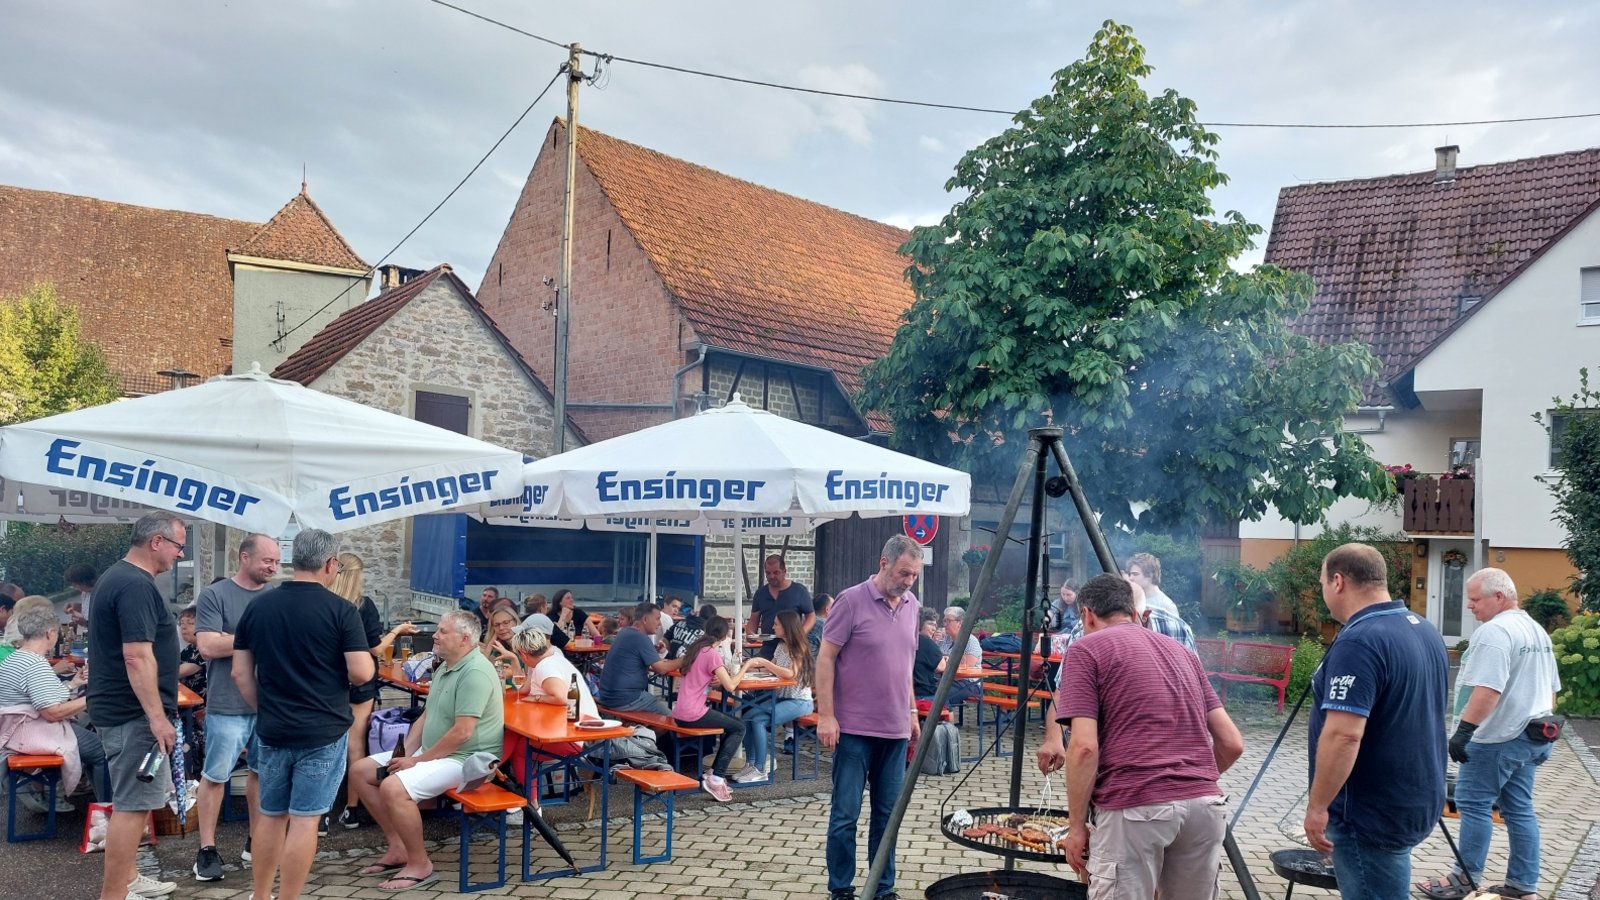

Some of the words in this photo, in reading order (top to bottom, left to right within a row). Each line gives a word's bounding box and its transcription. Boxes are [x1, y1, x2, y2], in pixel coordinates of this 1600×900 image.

[45, 439, 260, 516] Ensinger
[329, 470, 499, 520] Ensinger
[596, 471, 766, 508] Ensinger
[825, 470, 949, 508] Ensinger
[1329, 686, 1348, 700] 63
